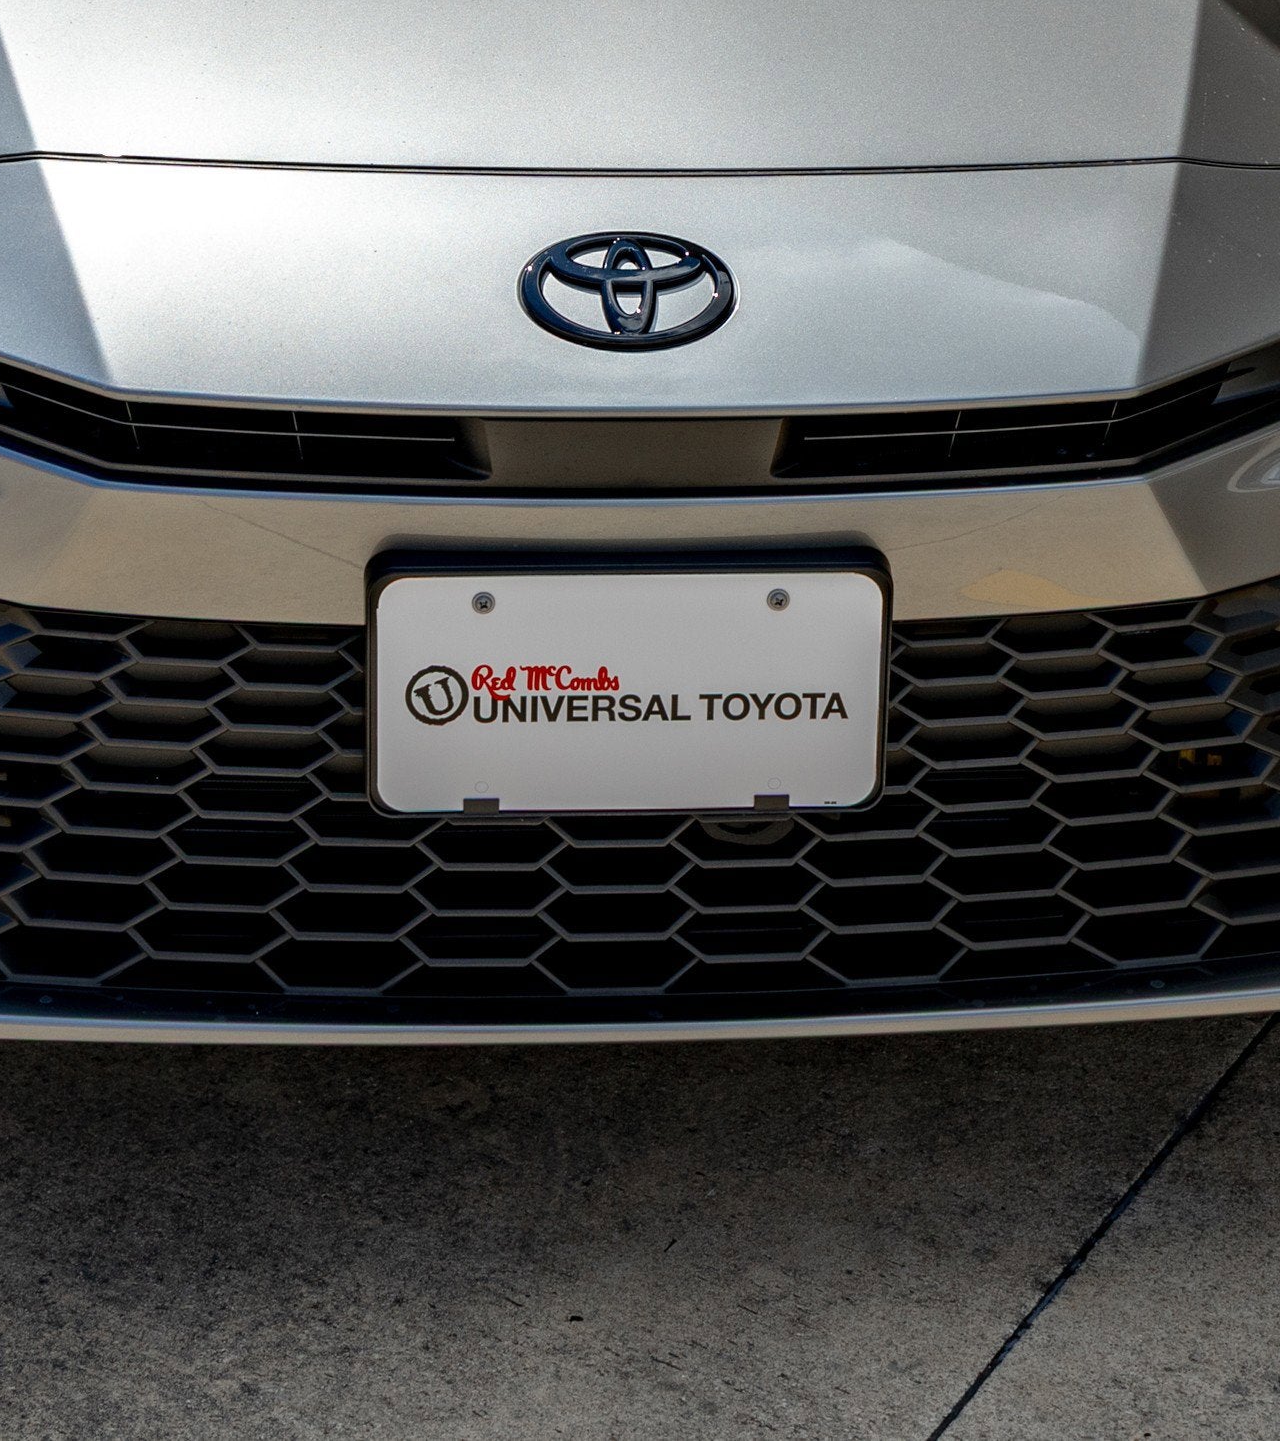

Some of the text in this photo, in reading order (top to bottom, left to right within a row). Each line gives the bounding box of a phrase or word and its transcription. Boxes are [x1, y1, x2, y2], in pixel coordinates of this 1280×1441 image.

[471, 664, 620, 701] Red McCombs
[472, 692, 849, 723] UNIVERSAL TOYOTA
